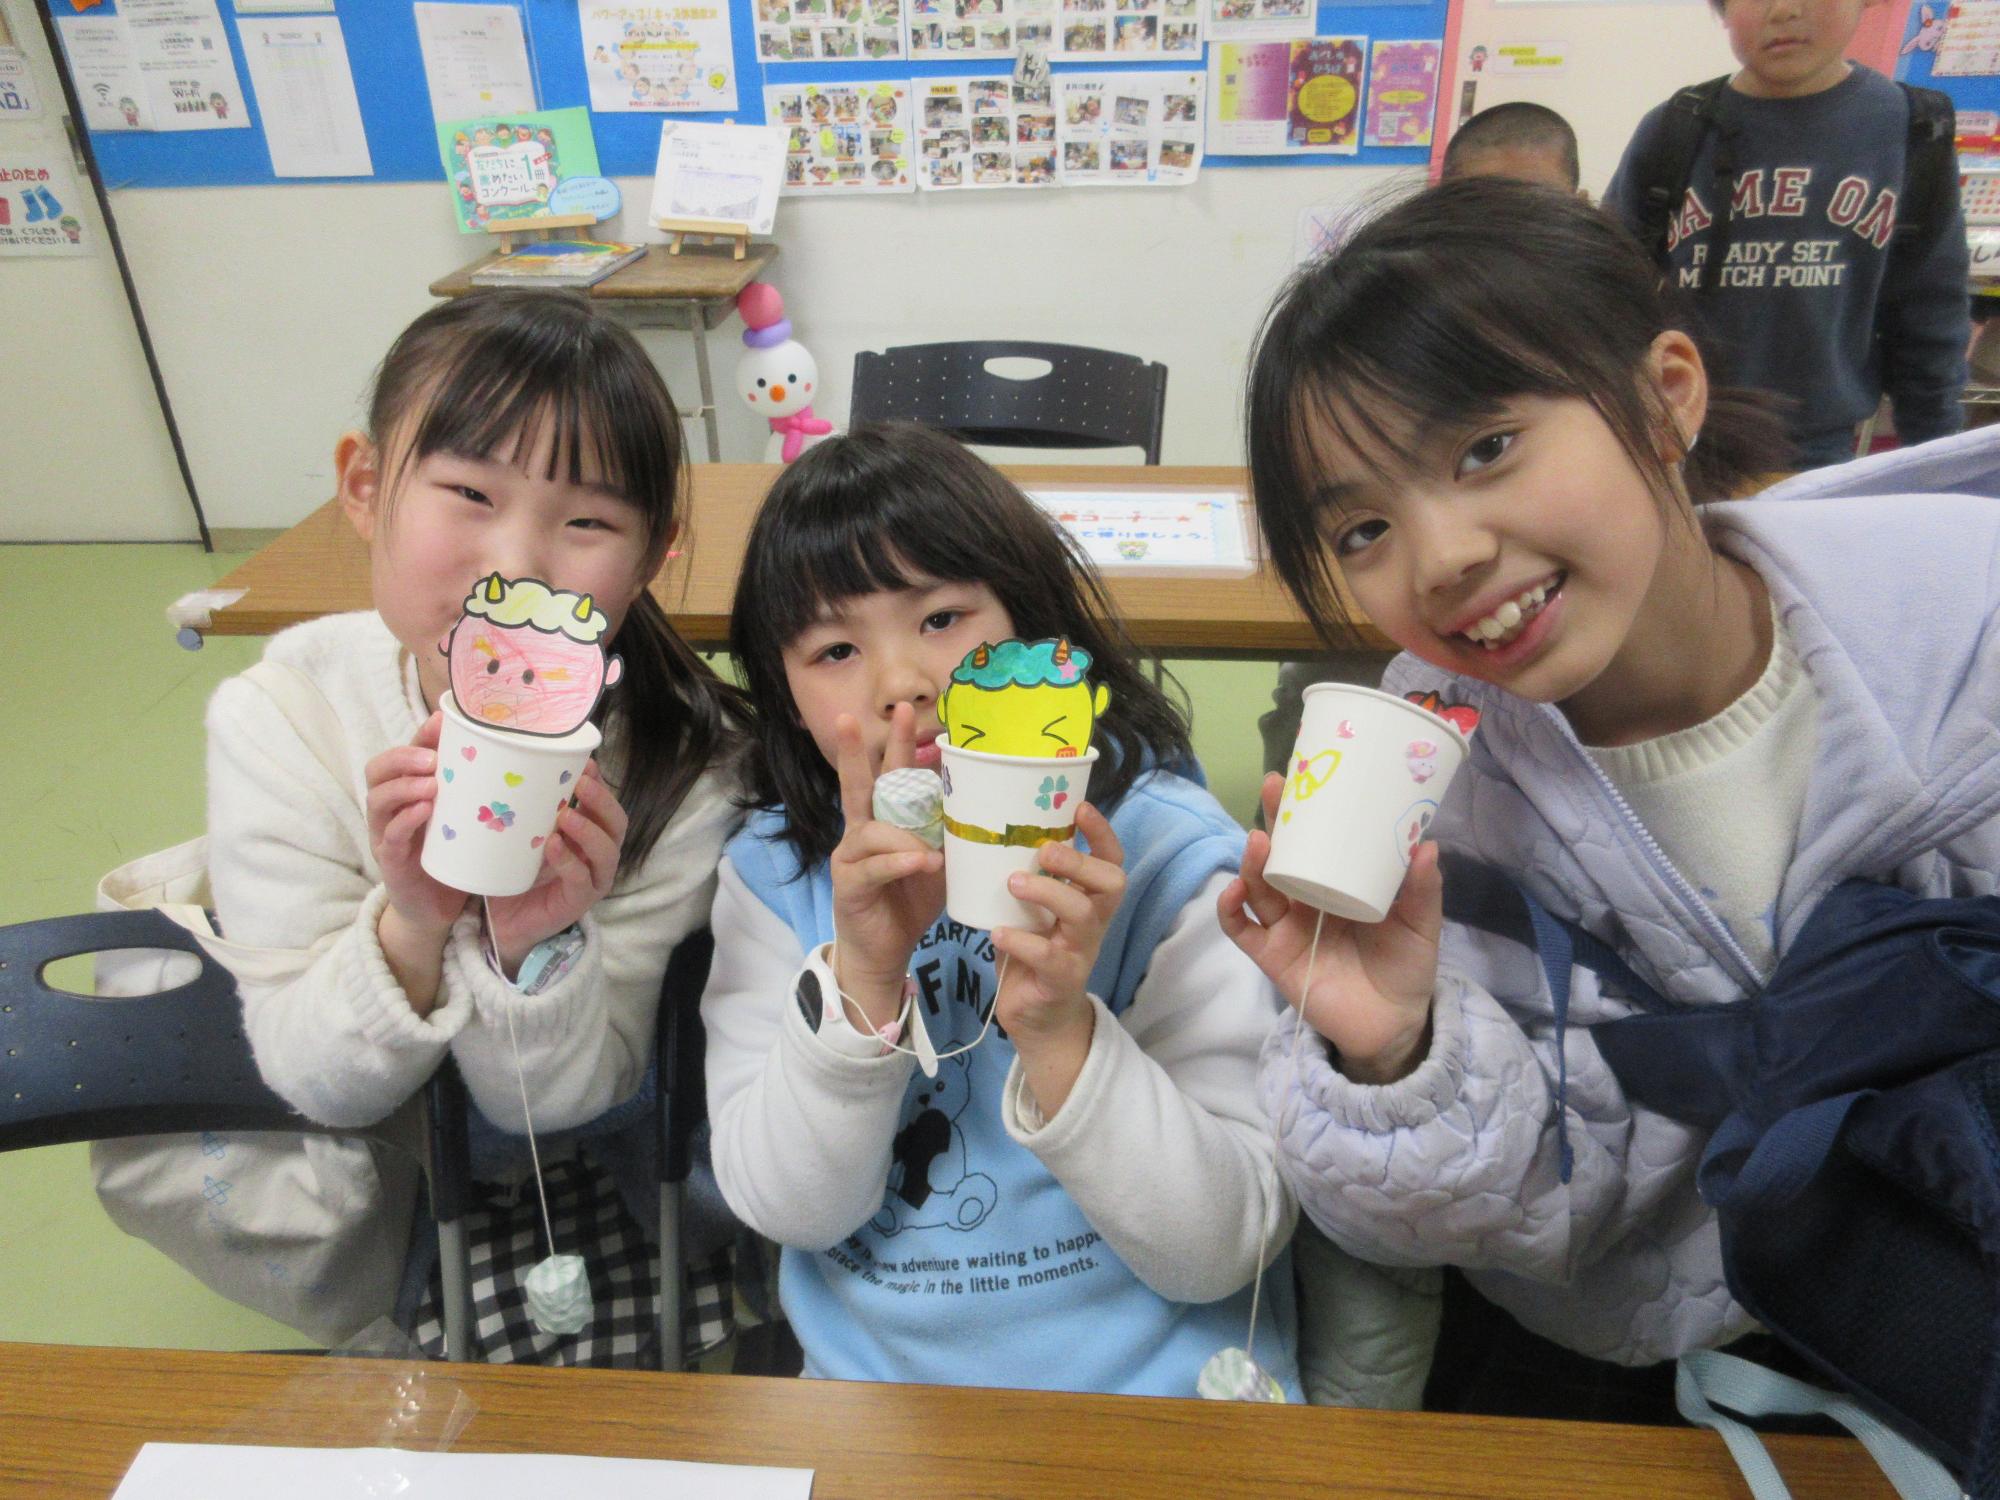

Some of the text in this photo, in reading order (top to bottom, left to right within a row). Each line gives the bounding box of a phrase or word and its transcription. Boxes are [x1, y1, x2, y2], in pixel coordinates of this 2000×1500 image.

[1692, 240, 1839, 266] RADY SET
[1678, 264, 1846, 289] MTCH POINT
[915, 922, 977, 952] EART
[901, 1257, 960, 1273] adventure
[966, 1250, 1027, 1268] waiting
[1033, 1247, 1050, 1260] to
[924, 1279, 937, 1294] in
[941, 1279, 964, 1294] the
[970, 1277, 1010, 1293] little
[1018, 1256, 1100, 1287] moments.
